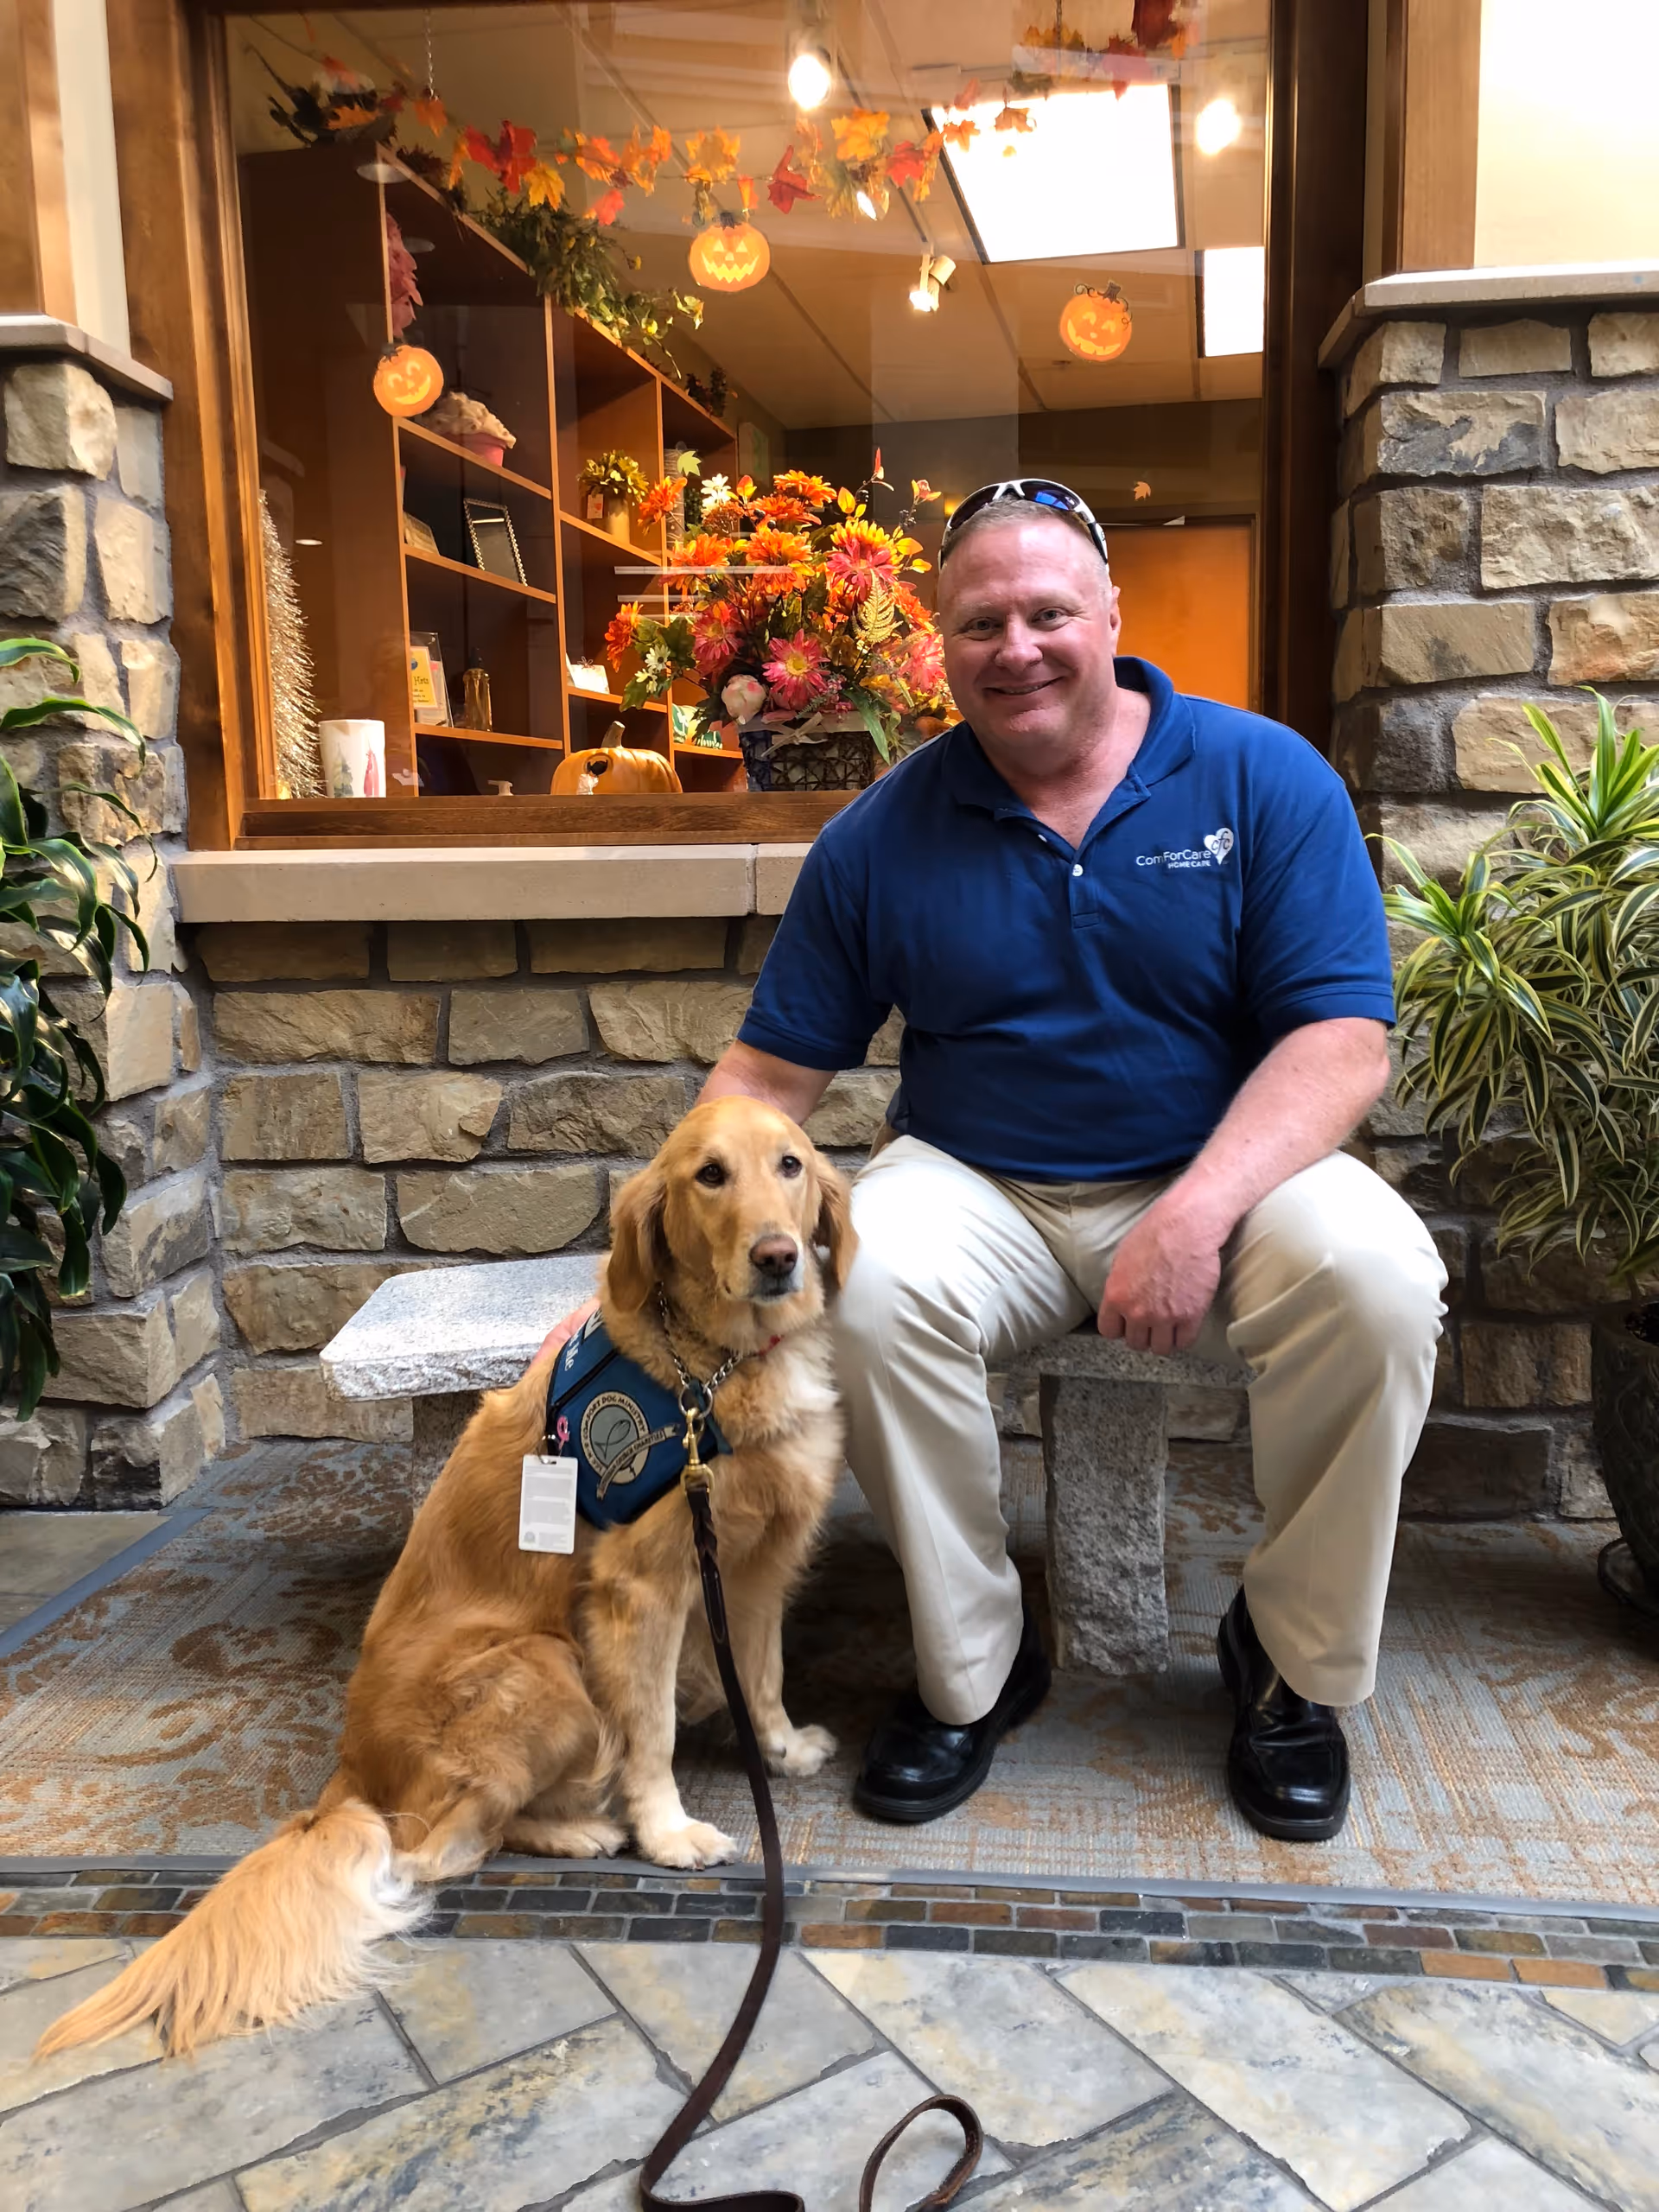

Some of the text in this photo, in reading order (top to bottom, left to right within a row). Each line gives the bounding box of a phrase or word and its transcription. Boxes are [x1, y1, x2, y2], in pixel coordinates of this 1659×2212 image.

[1135, 849, 1211, 866] ComForCare
[582, 1401, 601, 1439] COMFORT
[601, 1395, 617, 1404] DOG
[618, 1397, 645, 1433] MINISTRY
